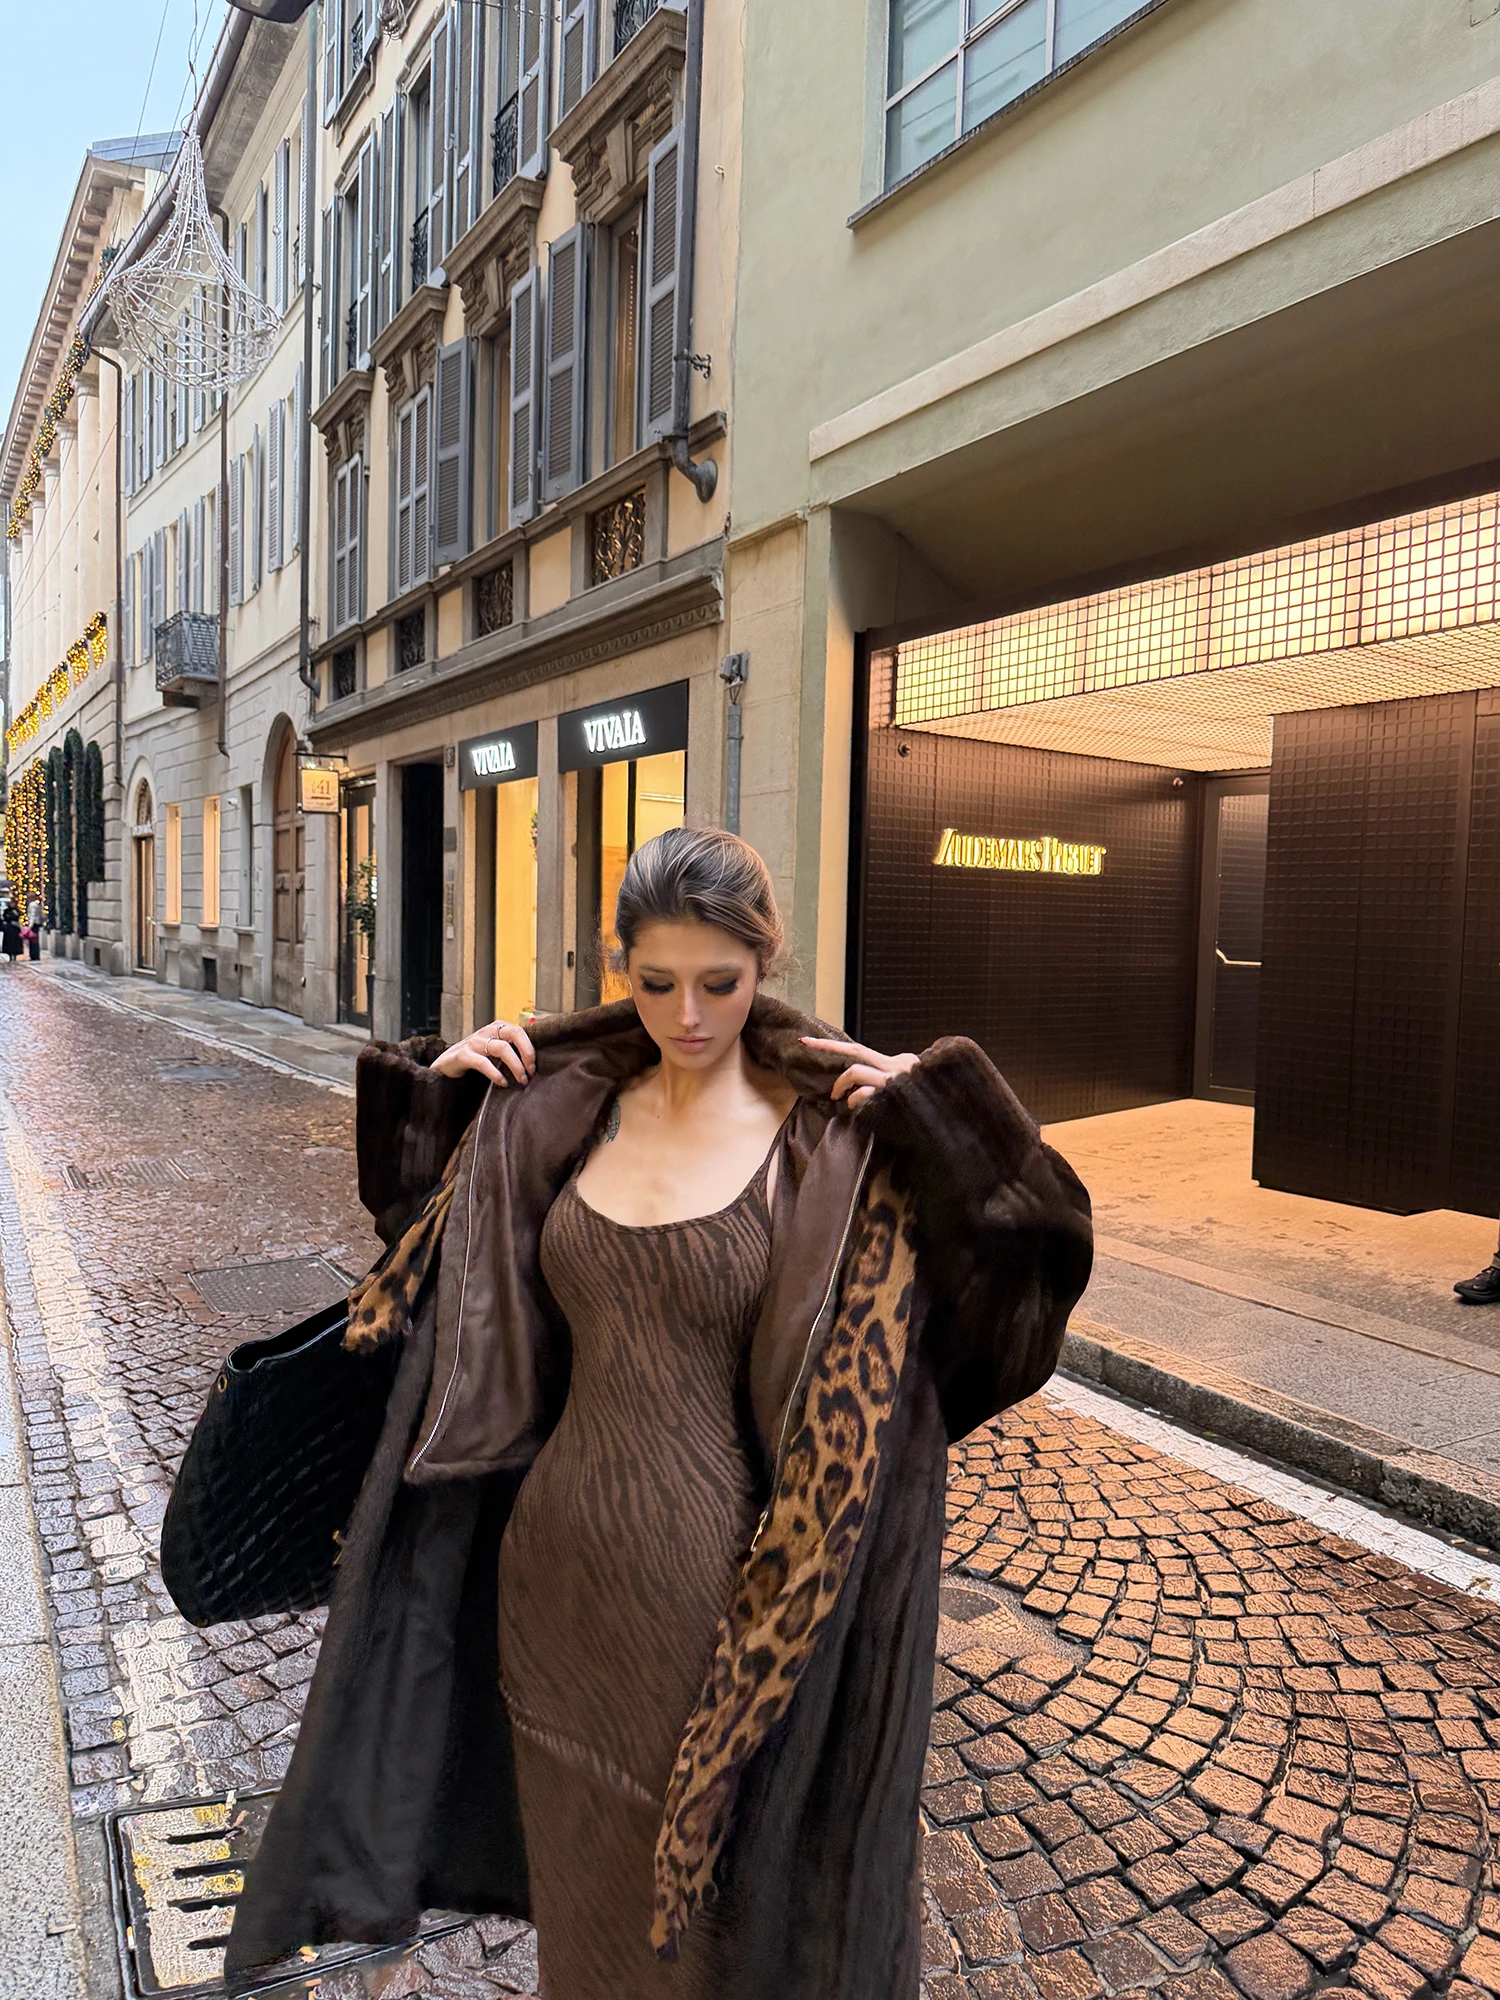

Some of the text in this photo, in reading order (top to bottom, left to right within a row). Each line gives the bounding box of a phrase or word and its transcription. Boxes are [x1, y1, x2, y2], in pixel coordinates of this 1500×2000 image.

[583, 710, 647, 753] VIVAIA
[471, 741, 517, 776] VIVAIA
[933, 828, 1042, 872] AUDEMARS
